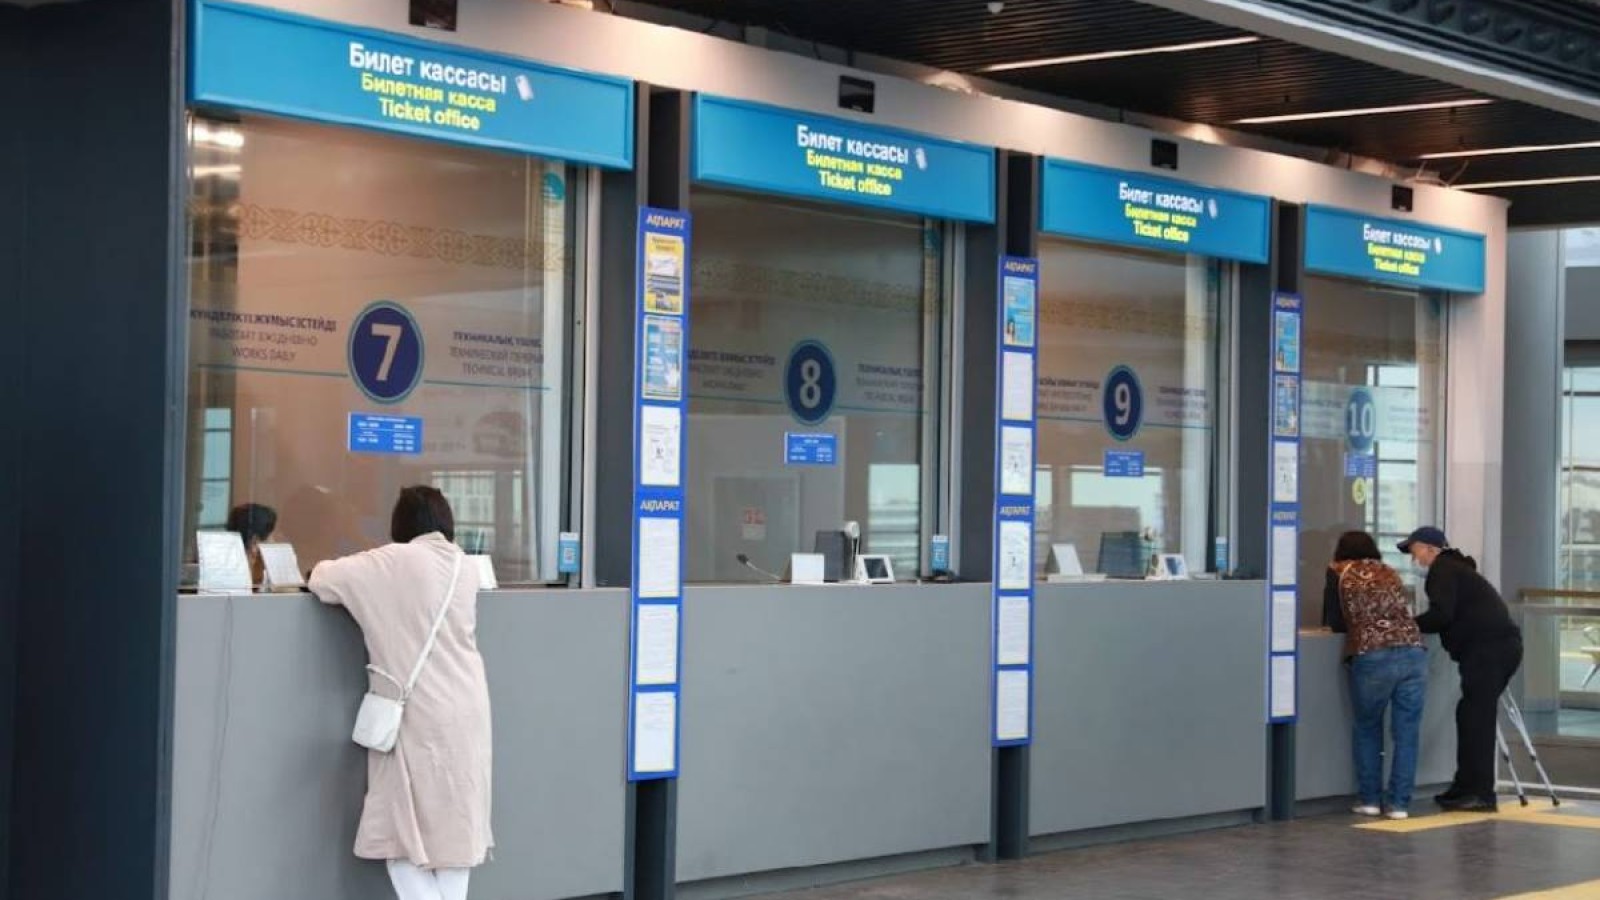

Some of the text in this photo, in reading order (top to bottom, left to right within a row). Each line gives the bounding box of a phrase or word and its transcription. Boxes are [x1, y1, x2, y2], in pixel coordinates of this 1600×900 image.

[349, 42, 506, 93] Билет кассасы
[361, 73, 496, 112] Билетная касса
[379, 98, 480, 130] Ticket office
[797, 124, 909, 164] Билет кассасы
[807, 149, 903, 180] Билетная касса
[819, 171, 892, 196] Ticket office
[1119, 182, 1203, 213] Билет кассасы
[372, 323, 403, 381] 7
[799, 359, 821, 409] 8
[1114, 382, 1131, 425] 9
[1349, 402, 1374, 437] 10
